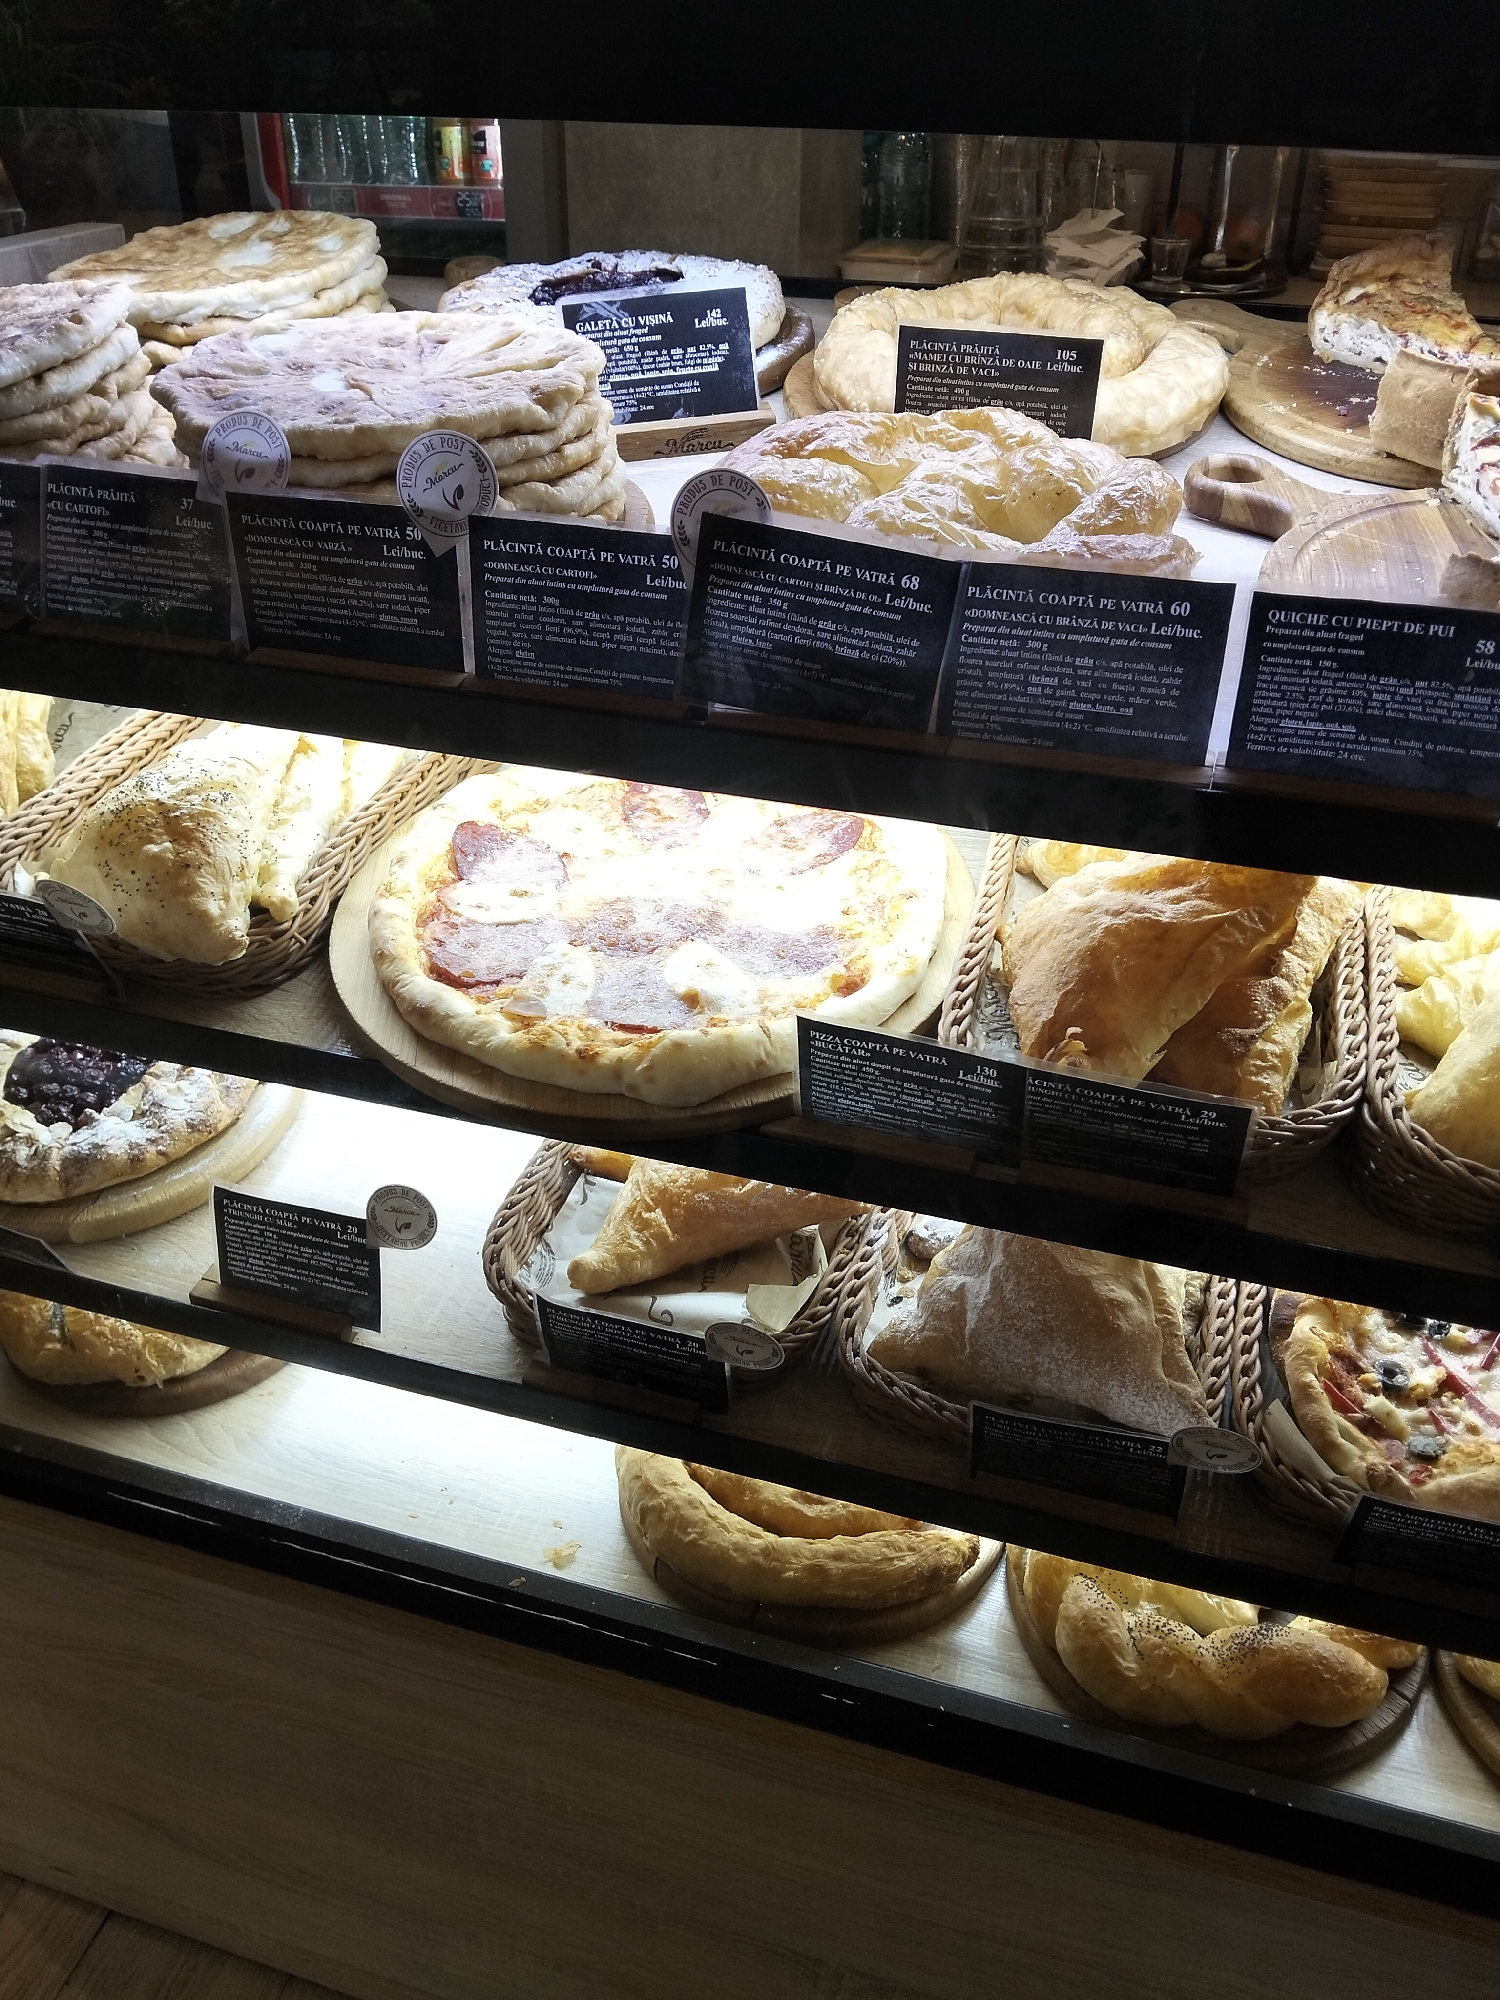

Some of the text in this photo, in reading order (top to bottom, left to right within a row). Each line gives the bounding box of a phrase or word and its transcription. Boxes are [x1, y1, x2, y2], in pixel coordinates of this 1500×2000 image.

[695, 316, 728, 328] Lei/buc.
[707, 308, 722, 318] 142
[576, 318, 619, 332] GALETĂ
[621, 317, 636, 327] CU
[910, 340, 1000, 355] PLĂCINTĂ PRĂJITĂ
[1056, 349, 1077, 360] 105
[909, 352, 946, 362] «MAMEI
[949, 355, 962, 363] CU
[1002, 359, 1015, 367] DE
[1018, 360, 1041, 369] OAIE
[1047, 362, 1083, 373] Lei/buc.
[957, 366, 969, 374] DE
[972, 367, 999, 376] VACI»
[215, 416, 283, 448] PRODUS DE POST
[226, 441, 269, 459] Marcu
[654, 438, 734, 455] Marcu
[402, 437, 466, 488] PRODUS DE POST
[423, 463, 464, 493] Marcu
[47, 482, 136, 503] PLĂCINTĂ PRĂJITĂ
[480, 478, 490, 507] ODUCT
[677, 480, 706, 515] PRODUS
[710, 475, 723, 486] DE
[729, 476, 755, 496] POST
[47, 501, 110, 517] «CU CARTOFI»
[180, 498, 193, 510] 37
[176, 515, 213, 531] Lei/buc.
[241, 515, 422, 540] PLĂCINTĂ COAPTĂ PE VATRĂ 50
[430, 516, 468, 533] VEGETARI
[244, 535, 300, 547] «DOMNEASCĂ
[302, 540, 313, 548] CU
[383, 545, 426, 559] Lei/buc.
[483, 540, 678, 569] PLĂCINTĂ COAPTĂ PE VATRĂ 50
[484, 561, 597, 579] «DOMNEASCĂ CU CARTOFI»
[712, 540, 920, 590] PLĂCINTĂ COAPTĂ PE VATRĂ 68
[710, 562, 764, 580] «DOMNEASCĂ
[766, 572, 777, 581] CU
[778, 575, 813, 588] CARTOFI
[856, 590, 867, 599] DE
[885, 594, 933, 613] Lei/buc.
[967, 585, 1191, 616] PLĂCINTĂ COAPTĂ PE VATRĂ 60
[964, 609, 1148, 633] «DOMNEASCĂ CU BRÂNZĂ DE VACI»
[1268, 610, 1456, 638] QUICHE CU PIEPT DE PUI
[963, 622, 996, 634] Preparat
[997, 625, 1009, 635] din
[1011, 626, 1031, 637] aluat
[1068, 632, 1109, 644] umplutură
[1110, 637, 1128, 647] gata
[1130, 637, 1139, 647] de
[1140, 641, 1172, 649] consum
[1150, 622, 1203, 639] Lei/buc.
[1266, 625, 1364, 642] Preparat din aluat fraged
[1475, 640, 1495, 654] 58
[1465, 657, 1500, 670] Lei/bu
[810, 1030, 948, 1066] PIZZA COAPTĂ PE VATRĂ
[810, 1039, 871, 1058] «BUCĂTAR»
[958, 1069, 1003, 1089] Lei/buc.
[976, 1065, 997, 1077] 130
[1028, 1086, 1062, 1097] IUNGHI
[1028, 1077, 1216, 1119] ĂCINTĂ COAPTĂ PE VATRĂ 29
[1181, 1114, 1228, 1128] Lei/buc.
[373, 1188, 397, 1204] PRODUS
[413, 1194, 429, 1209] POST
[223, 1199, 357, 1234] PLĂCINTĂ COAPTĂ PE VATRĂ 20
[384, 1206, 420, 1216] Marcu
[547, 1308, 592, 1323] PLĂCINTĂ
[595, 1319, 632, 1332] COAPTĂ
[650, 1332, 681, 1344] VATRĂ
[1148, 1445, 1163, 1453] 22
[1373, 1506, 1401, 1517] PIZZA
